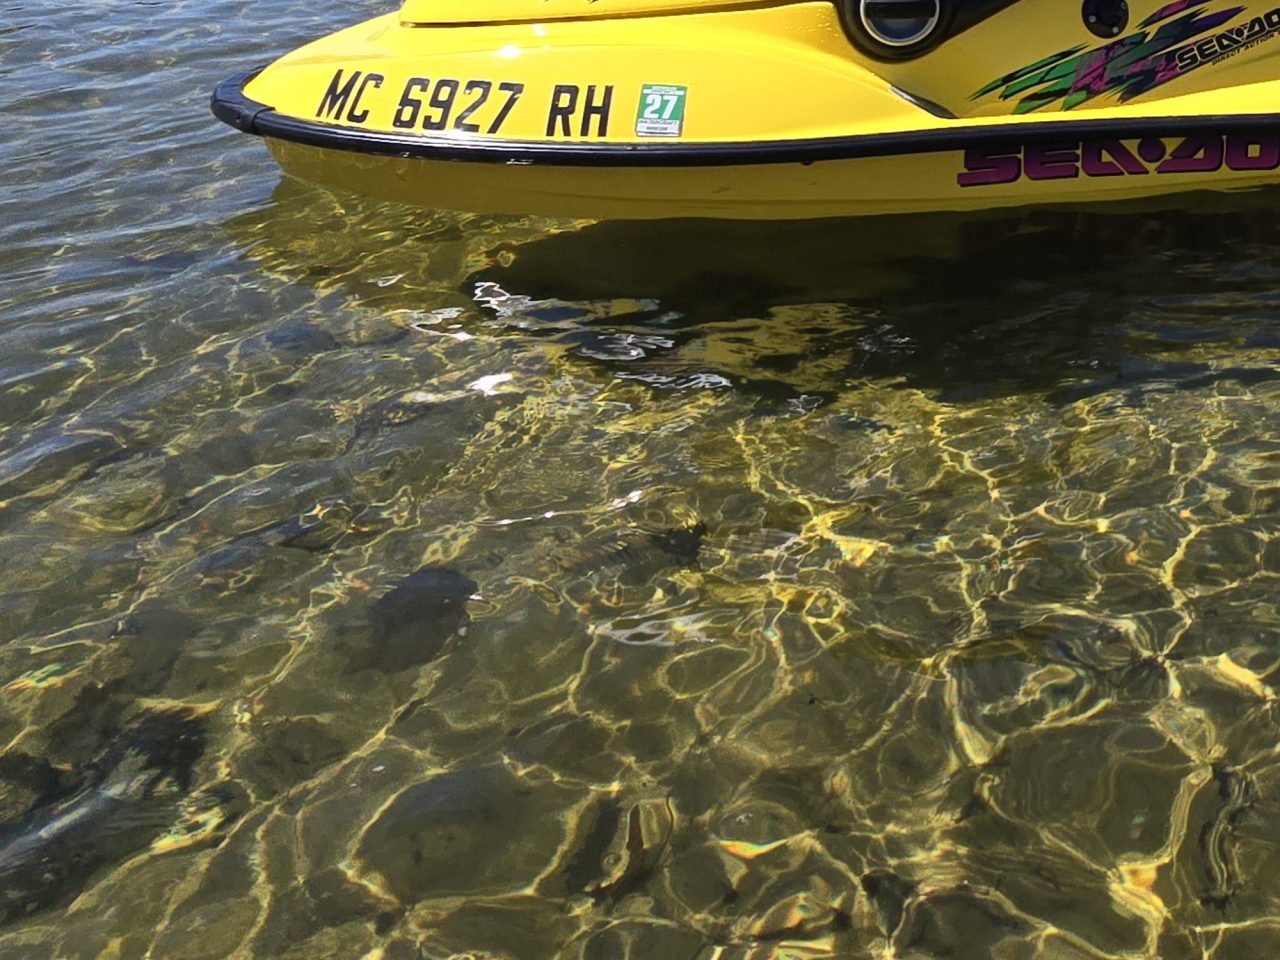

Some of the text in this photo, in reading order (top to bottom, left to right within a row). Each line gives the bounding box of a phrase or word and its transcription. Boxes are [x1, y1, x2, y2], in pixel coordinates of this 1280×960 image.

[1211, 48, 1241, 66] DIRECT
[1244, 33, 1275, 51] ACTION
[315, 69, 614, 137] MC 6927 RH
[643, 94, 678, 119] 27
